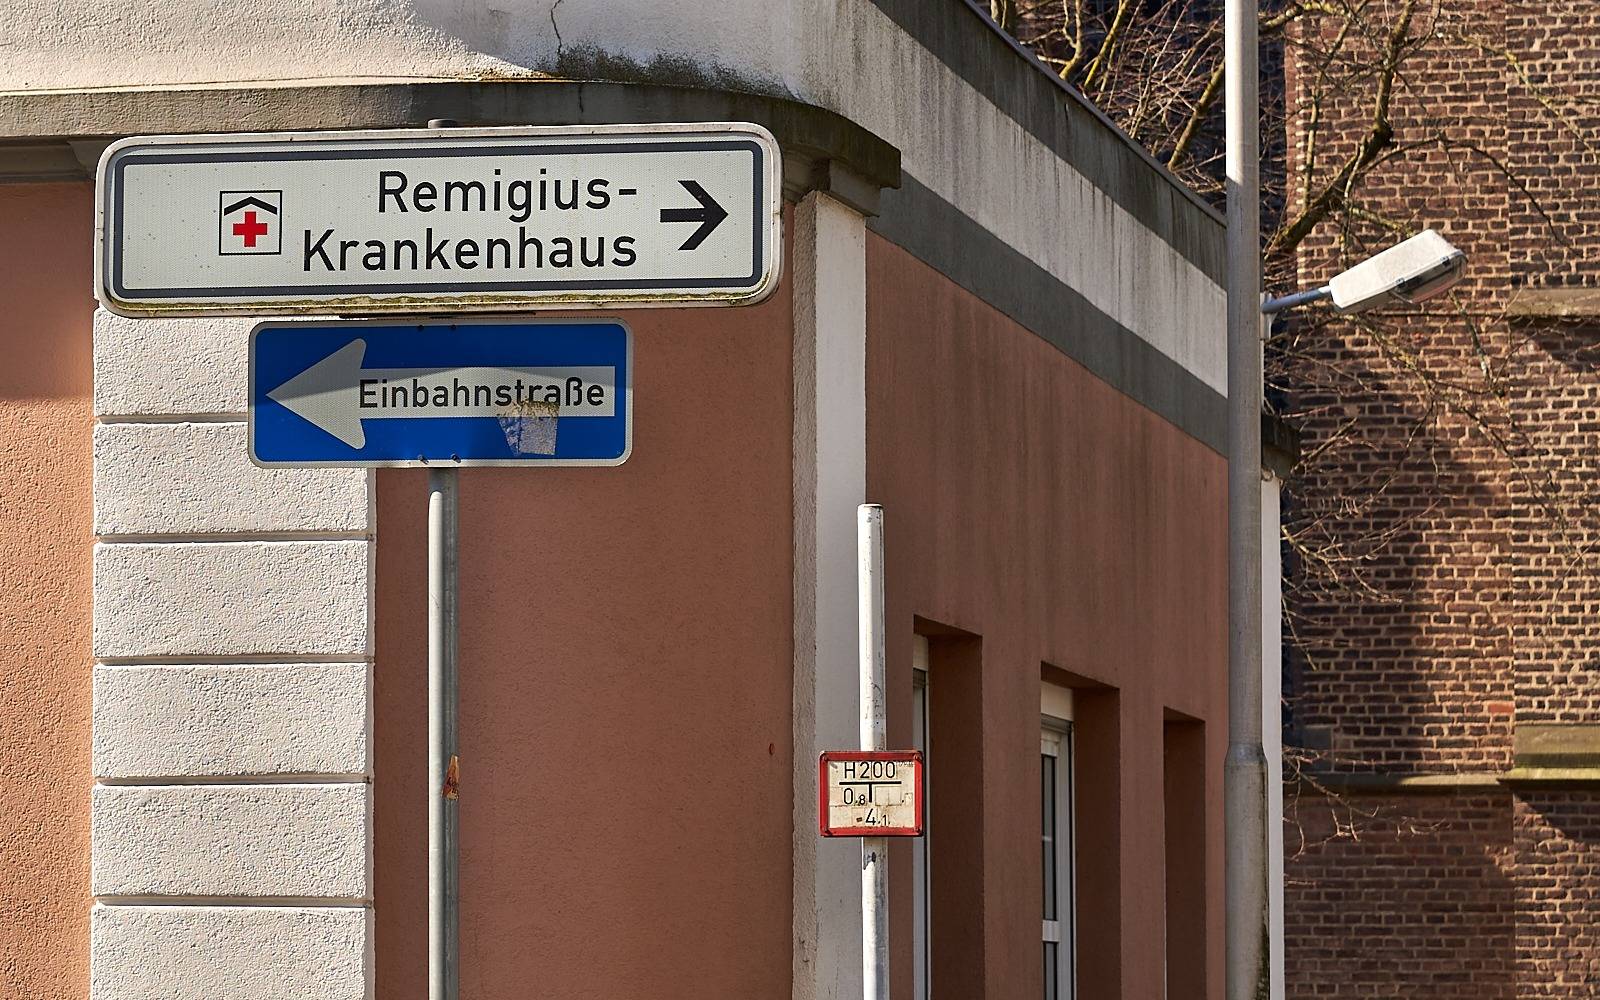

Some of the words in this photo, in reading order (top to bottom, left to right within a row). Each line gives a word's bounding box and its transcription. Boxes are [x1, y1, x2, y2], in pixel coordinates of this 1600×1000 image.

[378, 168, 637, 223] Remigius-
[303, 226, 637, 272] Krankenhaus
[358, 376, 605, 408] Einbahnstraße
